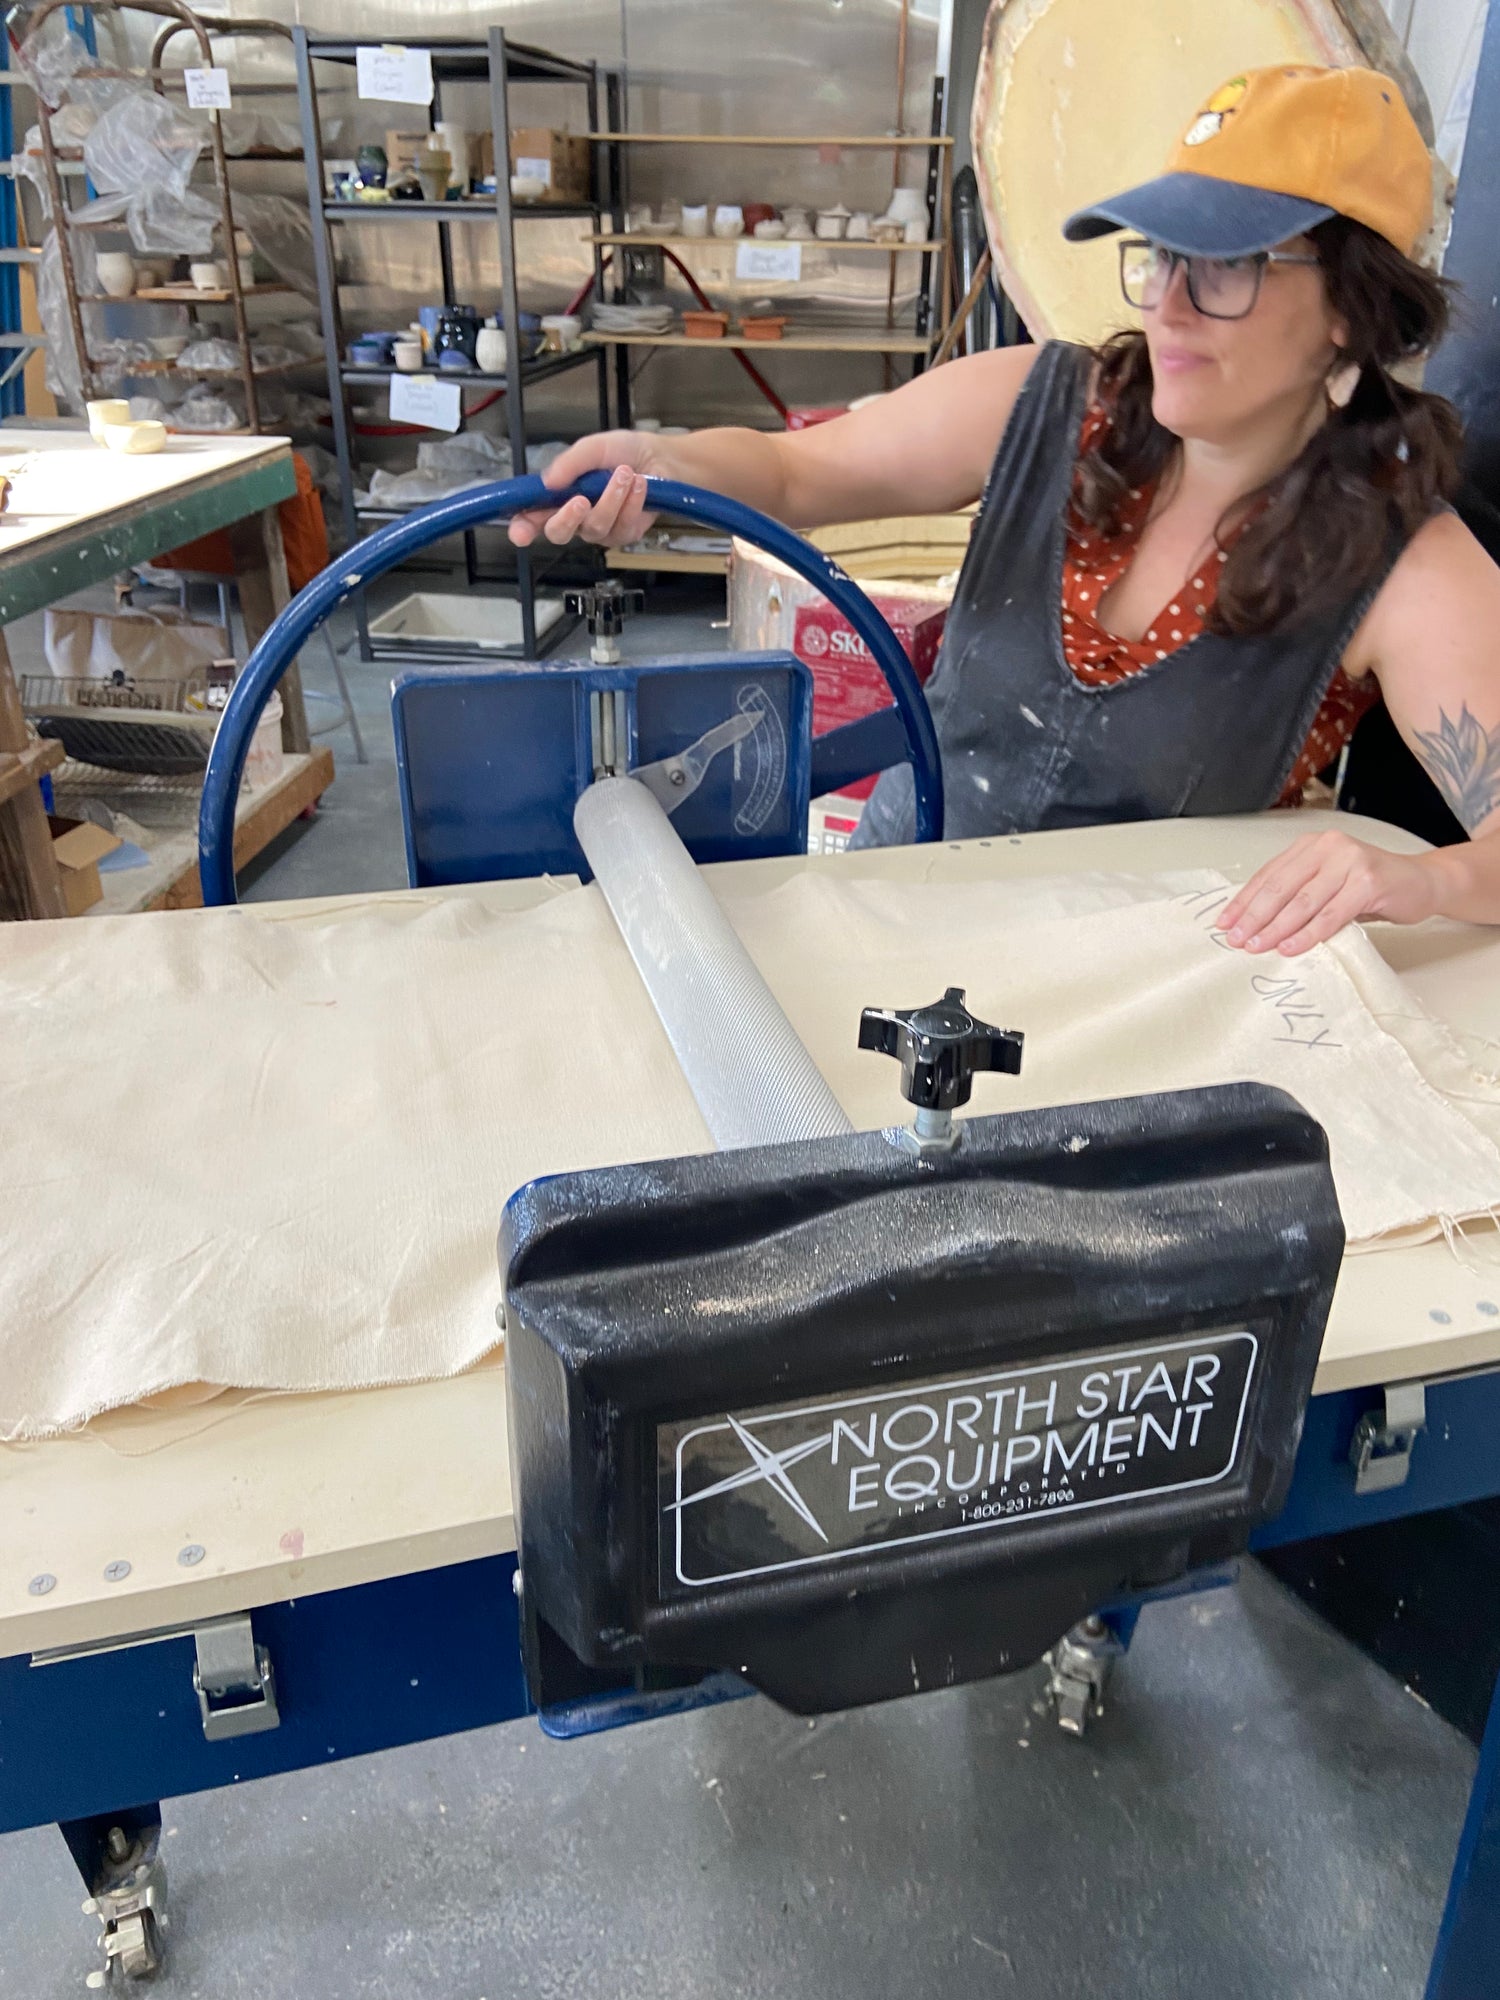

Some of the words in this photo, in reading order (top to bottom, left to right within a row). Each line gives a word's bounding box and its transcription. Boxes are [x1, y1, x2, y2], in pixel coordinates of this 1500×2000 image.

[831, 1379, 1058, 1466] NORTH
[1076, 1353, 1221, 1419] STAR
[848, 1401, 1214, 1512] EQUIPMENT
[897, 1462, 1126, 1517] INCORPORATED
